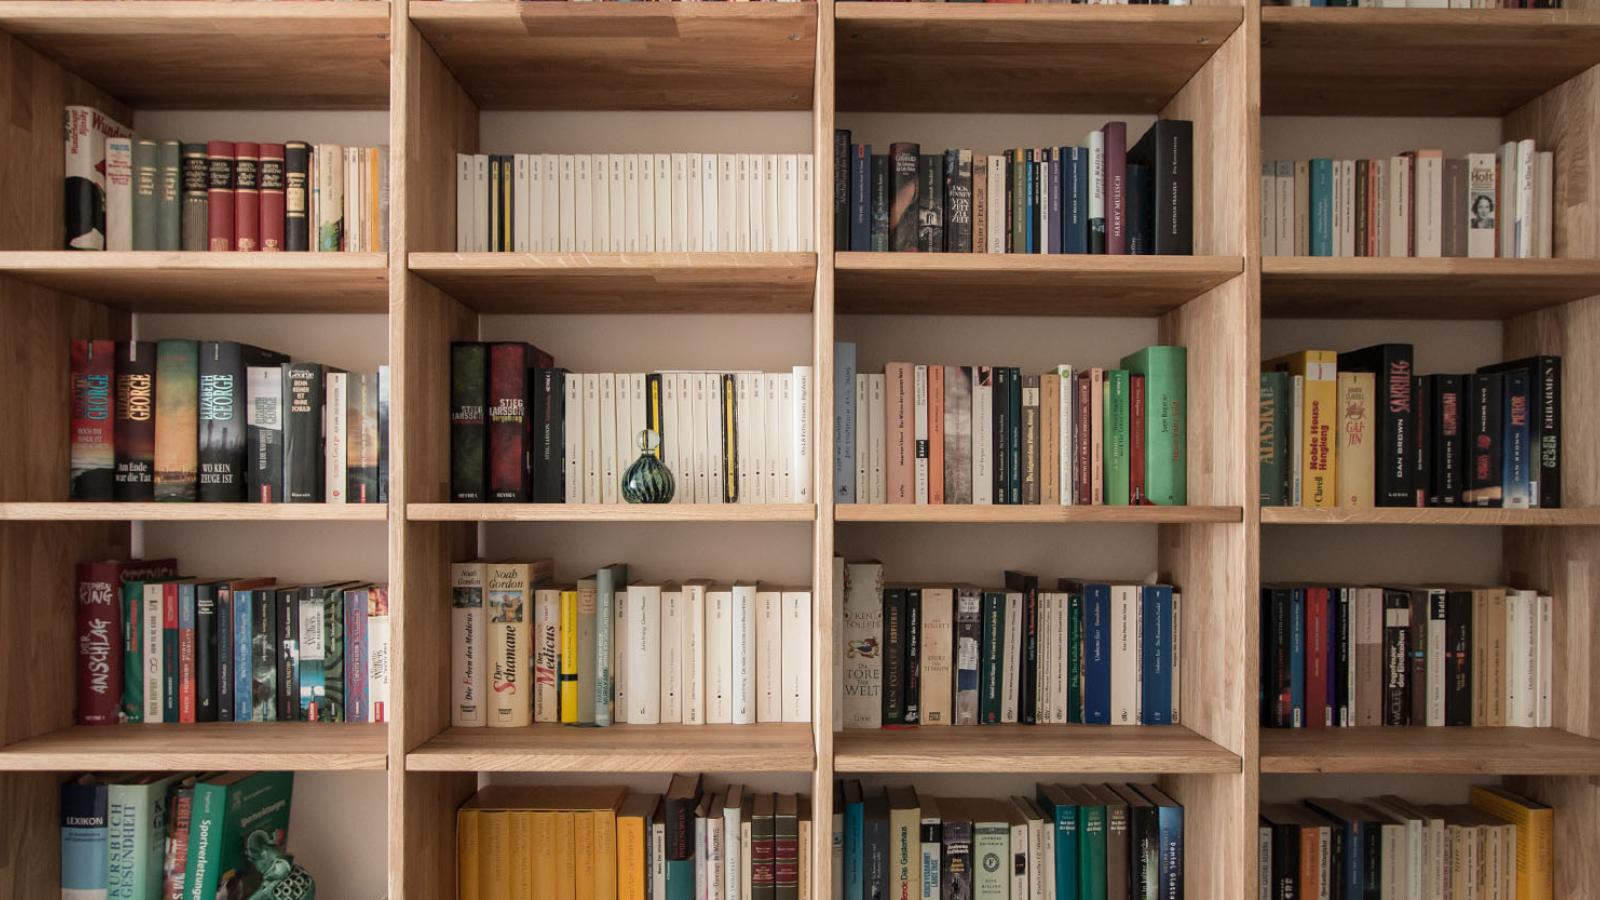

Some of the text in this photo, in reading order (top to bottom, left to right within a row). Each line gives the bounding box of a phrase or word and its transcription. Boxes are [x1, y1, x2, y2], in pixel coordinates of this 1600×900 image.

[1471, 172, 1494, 182] Holt
[87, 374, 110, 420] GEORGE
[130, 373, 152, 421] GEORGE
[200, 375, 213, 420] ELIZABETH
[212, 374, 233, 420] GEORGE
[1390, 360, 1411, 414] SAKRILEG
[1544, 367, 1554, 429] ERBARMEN
[489, 407, 525, 416] LARSSON
[499, 399, 523, 407] STIEG
[1511, 395, 1526, 426] METEOR
[1259, 399, 1274, 464] ALASKA
[1310, 400, 1318, 470] Noble House
[1549, 435, 1557, 468] OLSEN
[130, 462, 148, 472] Ende
[200, 474, 233, 483] ZEUGE IST
[202, 464, 231, 473] WO KEIN
[1314, 476, 1323, 502] Clavell
[489, 579, 524, 590] Gordon
[494, 569, 518, 580] Noah
[80, 590, 113, 605] KING
[846, 620, 880, 628] FOLLETT
[855, 612, 873, 620] KEN
[80, 633, 91, 655] DER
[89, 618, 111, 694] ANSCHLAG
[464, 613, 473, 700] Die Erben des Medicus
[536, 625, 556, 686] Medicus
[493, 626, 517, 695] Schamane
[493, 662, 502, 680] Der
[1389, 645, 1397, 688] Fegefeuer
[1397, 629, 1405, 688] der Eitelkeiten
[846, 669, 880, 679] TORE
[845, 685, 881, 697] WELT
[889, 690, 897, 708] KEN
[67, 816, 104, 825] LEXIKON
[110, 804, 122, 898] KURSBUCH
[122, 804, 136, 898] GESUNDHEIT
